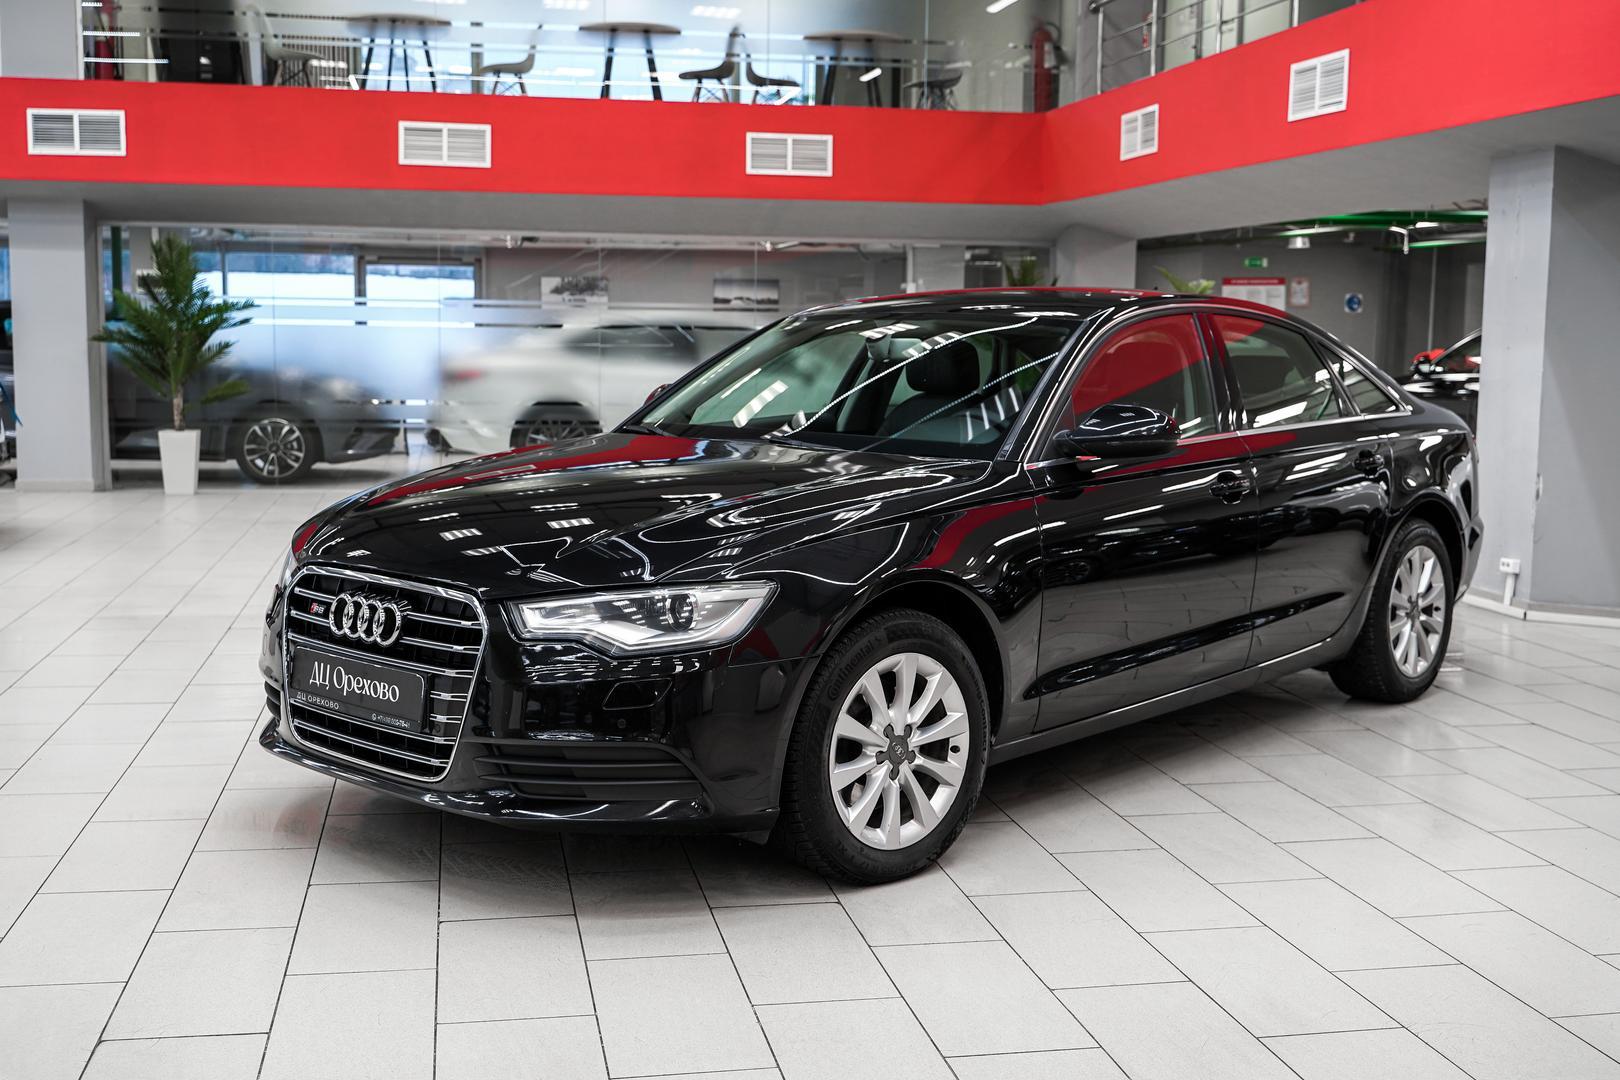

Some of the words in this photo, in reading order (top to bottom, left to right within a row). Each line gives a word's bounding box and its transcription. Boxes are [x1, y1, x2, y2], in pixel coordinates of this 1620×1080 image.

[309, 661, 331, 690] ДЦ
[333, 666, 400, 703] Орехово
[826, 638, 874, 701] Continental
[296, 691, 307, 702] ДЦ
[307, 695, 340, 710] ОРЕХОВО
